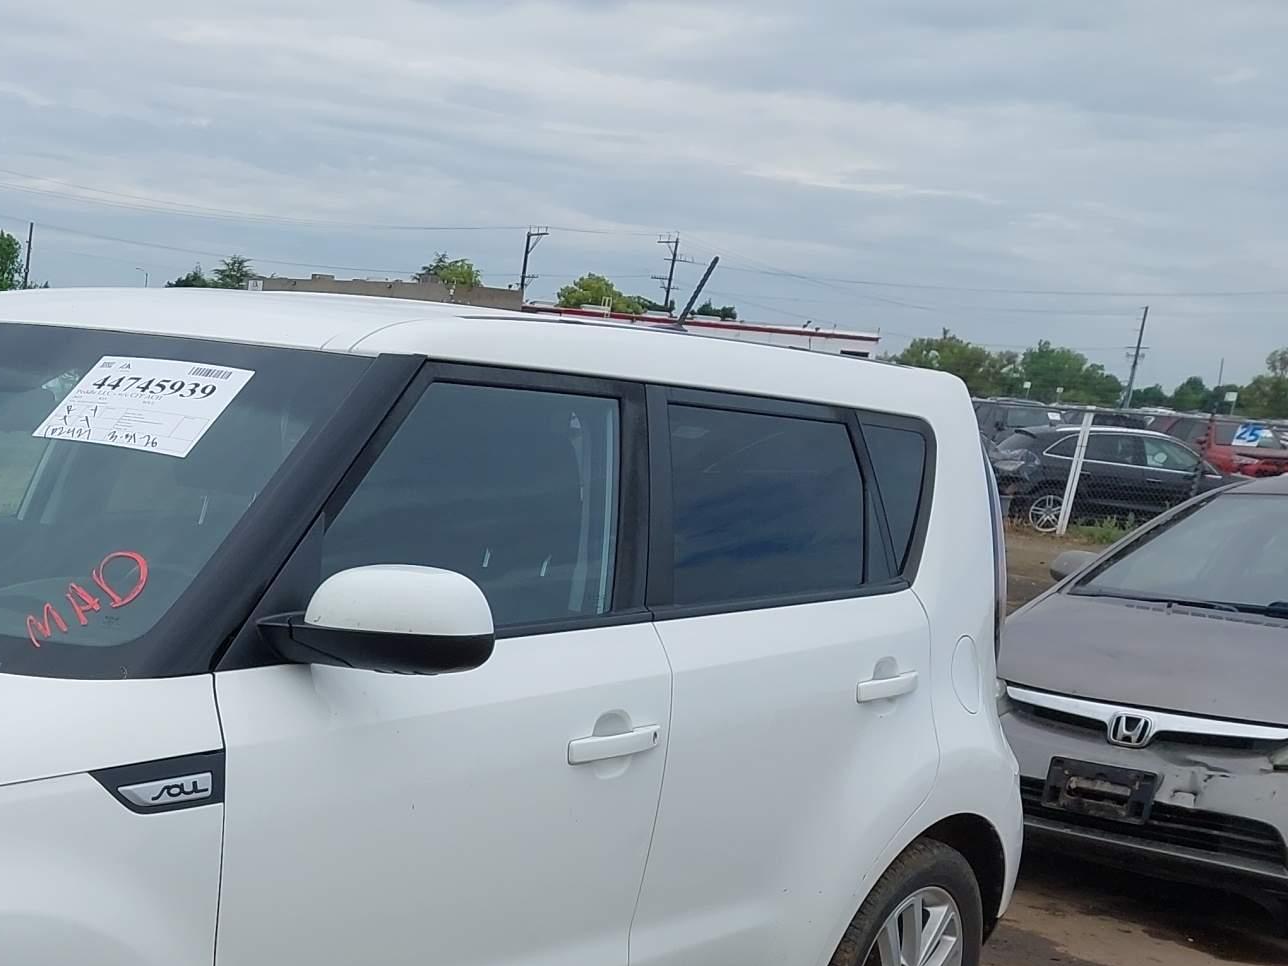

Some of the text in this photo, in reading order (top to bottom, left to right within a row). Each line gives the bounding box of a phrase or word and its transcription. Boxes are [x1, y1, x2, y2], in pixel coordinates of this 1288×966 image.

[92, 374, 217, 400] 44745939
[1235, 422, 1265, 443] 25
[25, 550, 150, 648] MAD
[150, 780, 209, 802] SOUL
